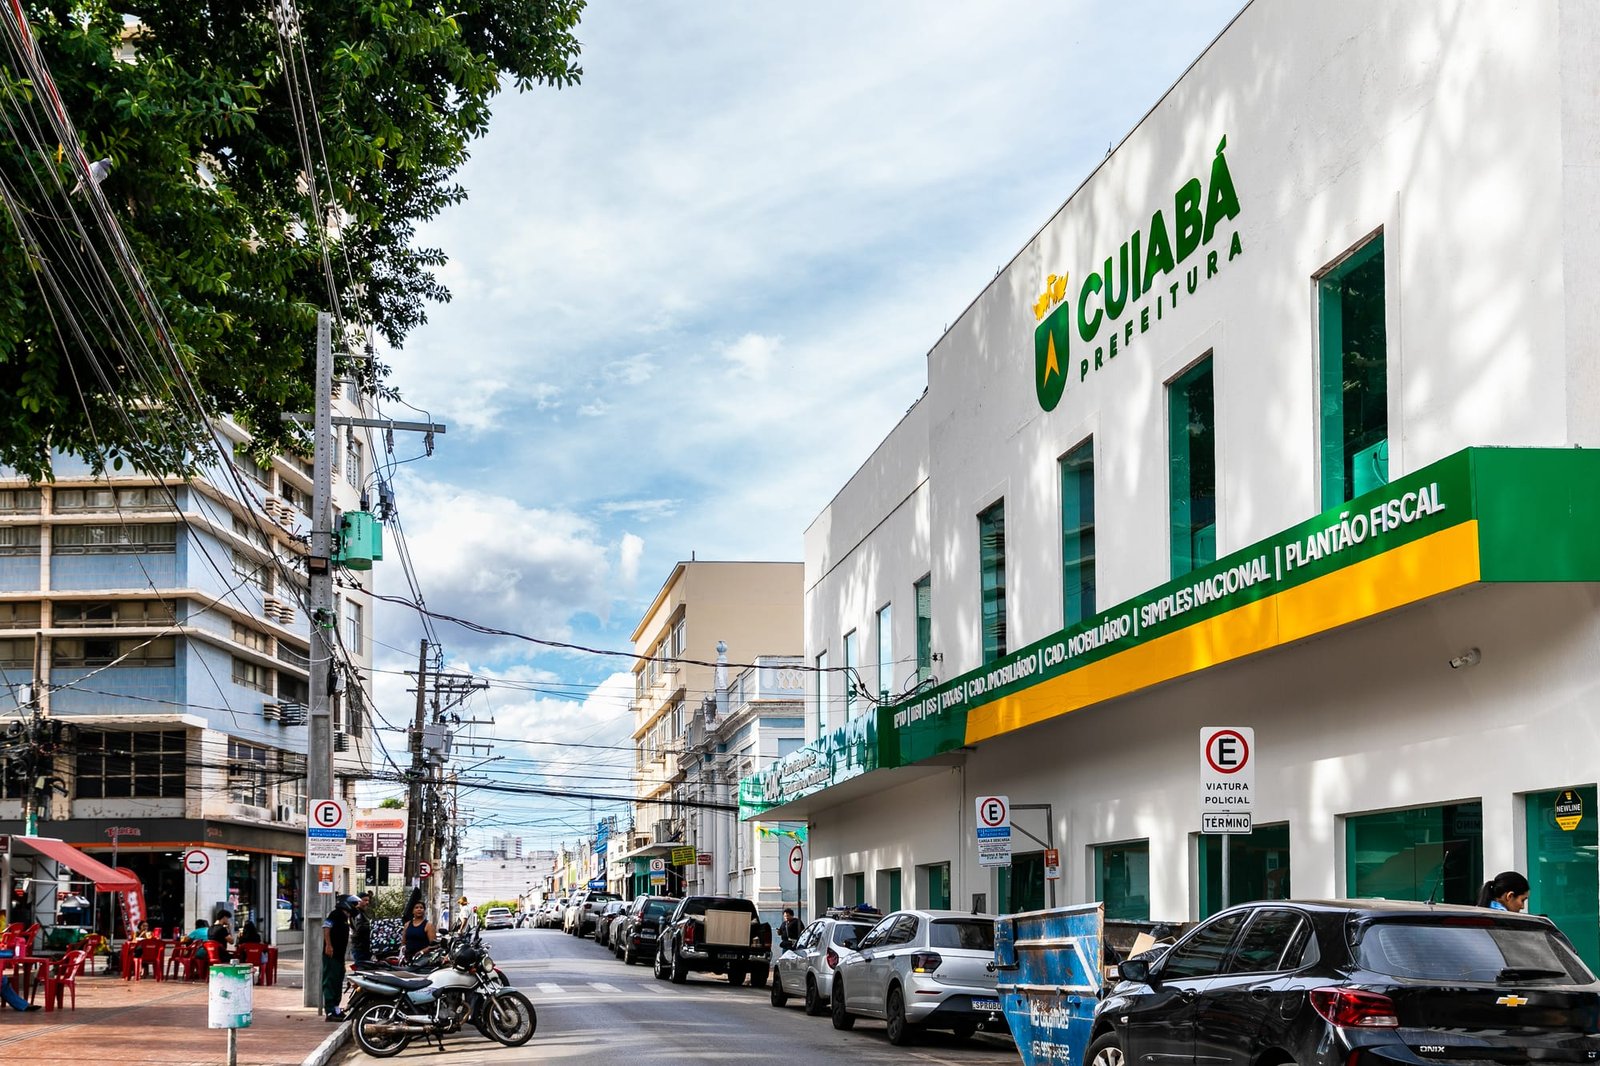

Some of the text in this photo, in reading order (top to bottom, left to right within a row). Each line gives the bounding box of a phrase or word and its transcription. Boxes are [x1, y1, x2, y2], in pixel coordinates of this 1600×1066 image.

[1077, 134, 1240, 342] CUIABÁ
[1081, 231, 1242, 382] PREFEITURA
[894, 710, 906, 729] IPTU
[926, 697, 937, 716] ISS
[941, 686, 963, 709] TAXAS
[968, 676, 987, 698] CAD.
[988, 656, 1036, 691] IMOBILIÁRIO
[1044, 643, 1068, 666] CAD.
[1068, 617, 1130, 656] MOBILIÁRIO
[1141, 587, 1193, 628] SIMPLES
[1194, 556, 1271, 608] NACIONAL
[1286, 511, 1368, 571] PLANTÃO
[1370, 482, 1446, 537] FISCAL
[1218, 738, 1237, 765] E
[1206, 782, 1249, 790] VIATURA
[324, 807, 334, 822] E
[988, 804, 998, 820] E
[1556, 804, 1581, 812] NEWLINE
[1204, 816, 1249, 828] TÉRMINO
